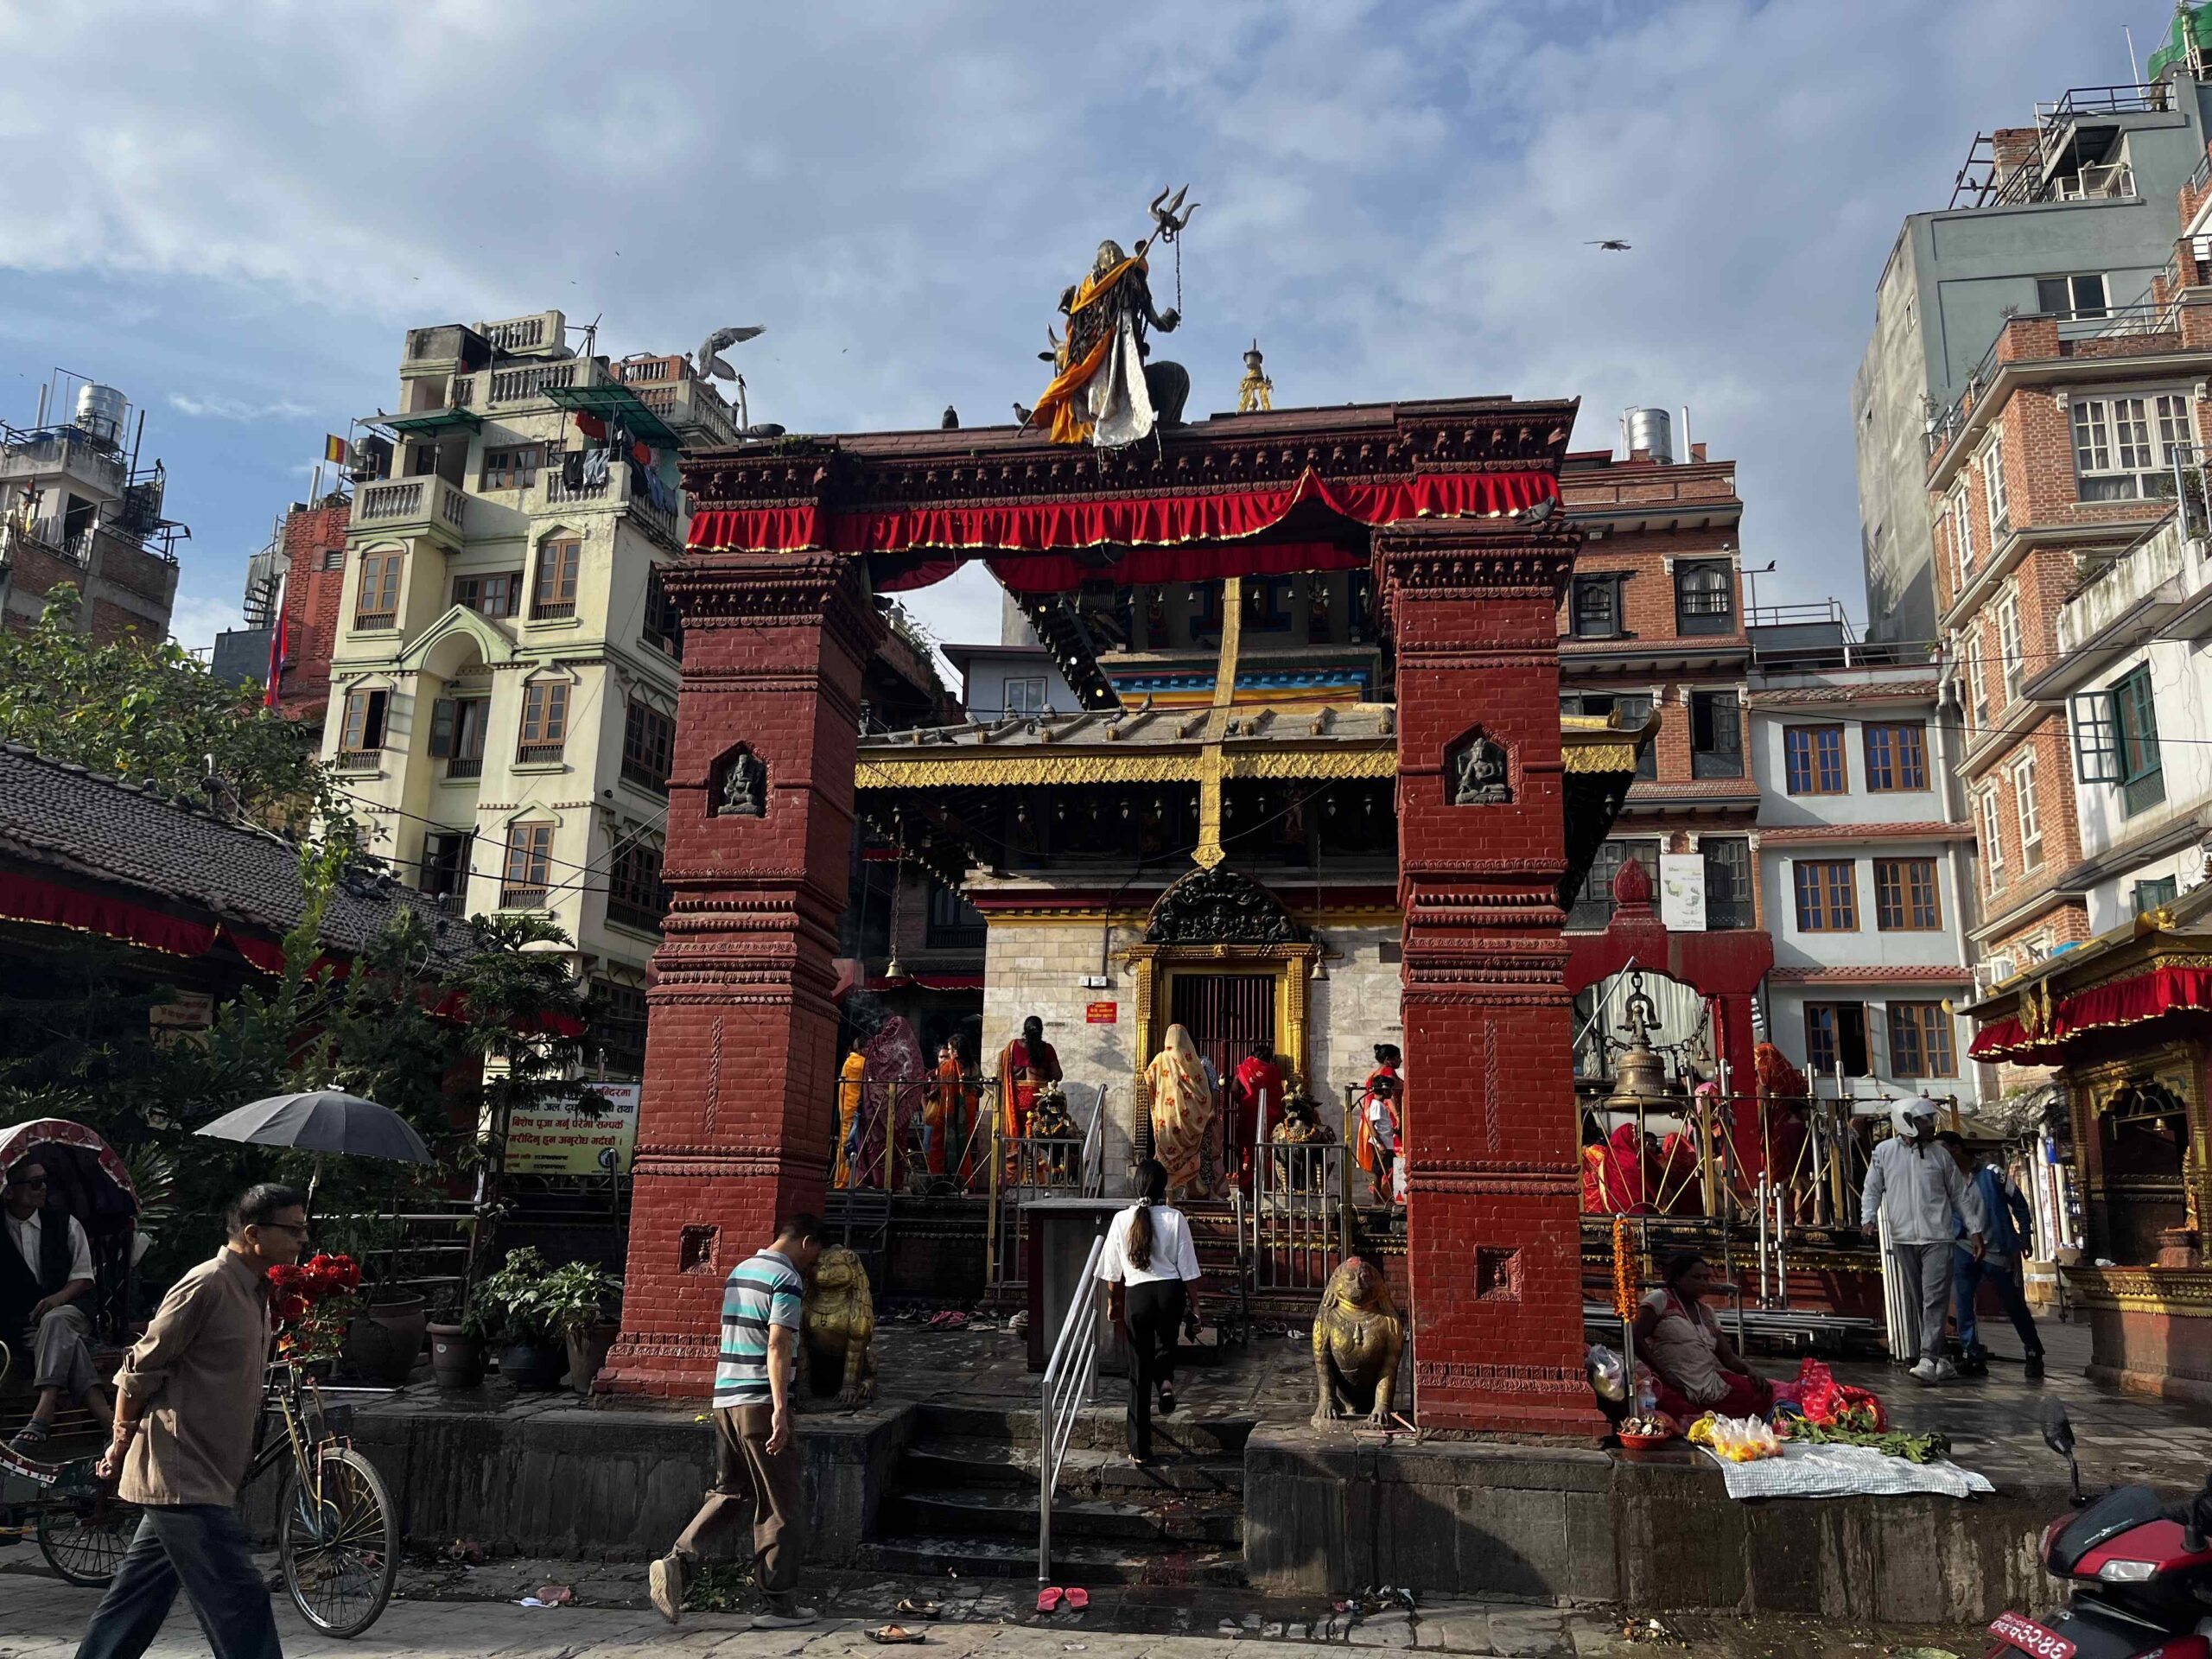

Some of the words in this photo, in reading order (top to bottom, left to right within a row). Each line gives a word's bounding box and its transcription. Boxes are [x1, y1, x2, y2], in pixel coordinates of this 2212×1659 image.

[616, 1105, 634, 1114] तथा
[536, 1119, 554, 1129] पूजा
[595, 1119, 624, 1129] सम्पर्क
[558, 1134, 588, 1147] अनुरोध
